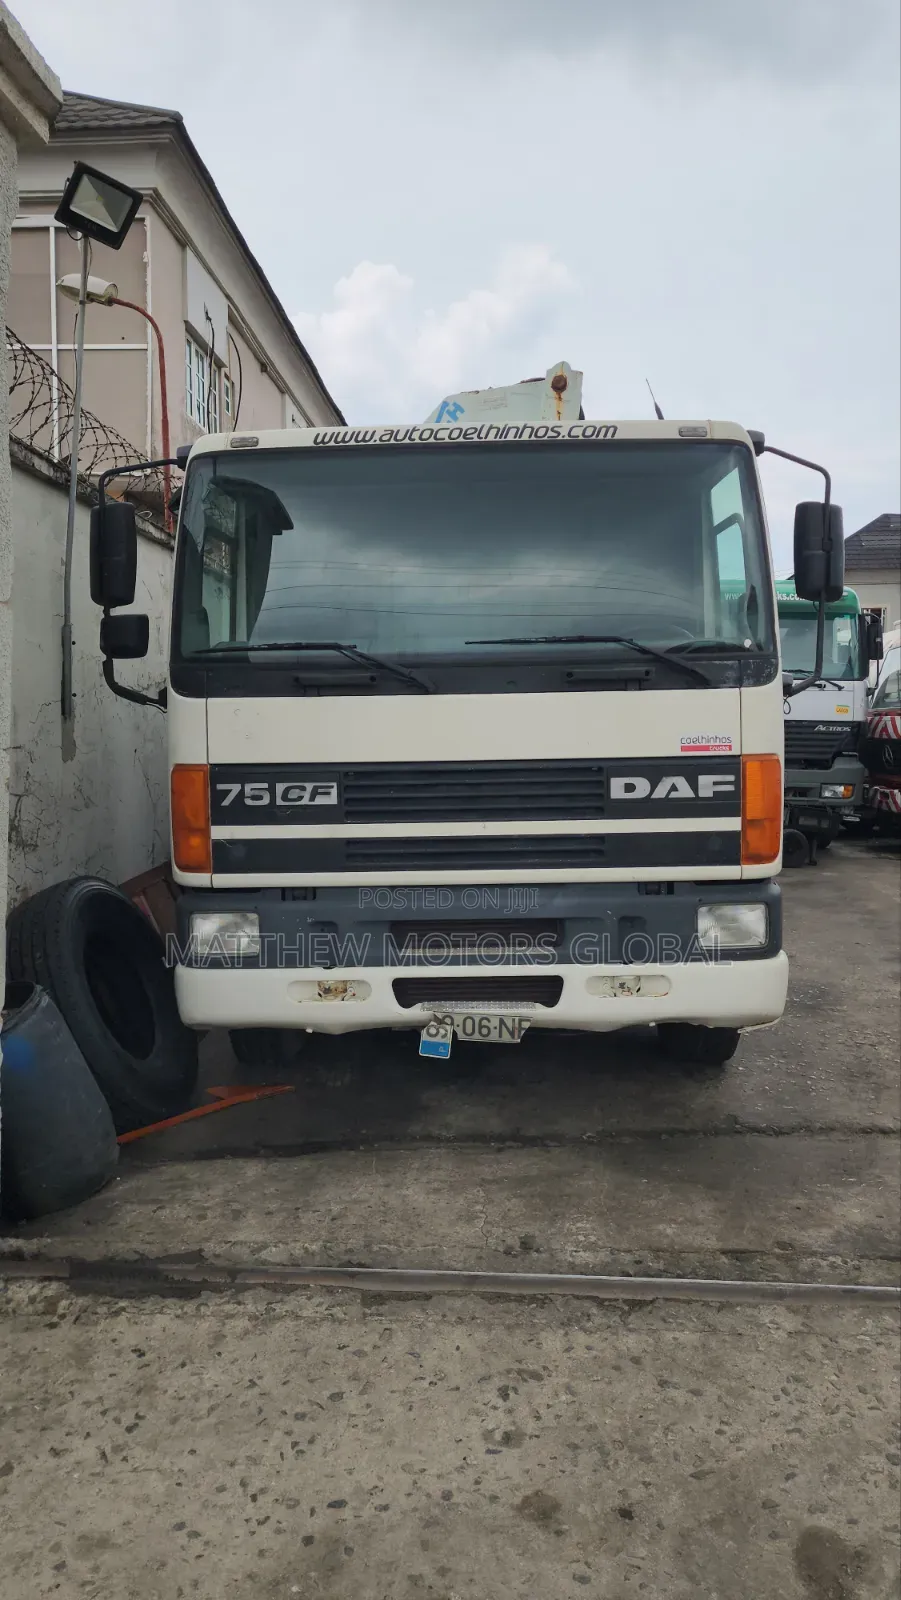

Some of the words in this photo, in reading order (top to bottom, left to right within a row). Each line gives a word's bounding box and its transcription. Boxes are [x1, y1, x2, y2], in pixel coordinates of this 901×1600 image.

[313, 422, 618, 446] www.autocoelhinhos.com
[680, 735, 732, 745] coelhinhos
[216, 782, 270, 806] 75
[279, 784, 335, 803] CF
[610, 775, 736, 799] DAF
